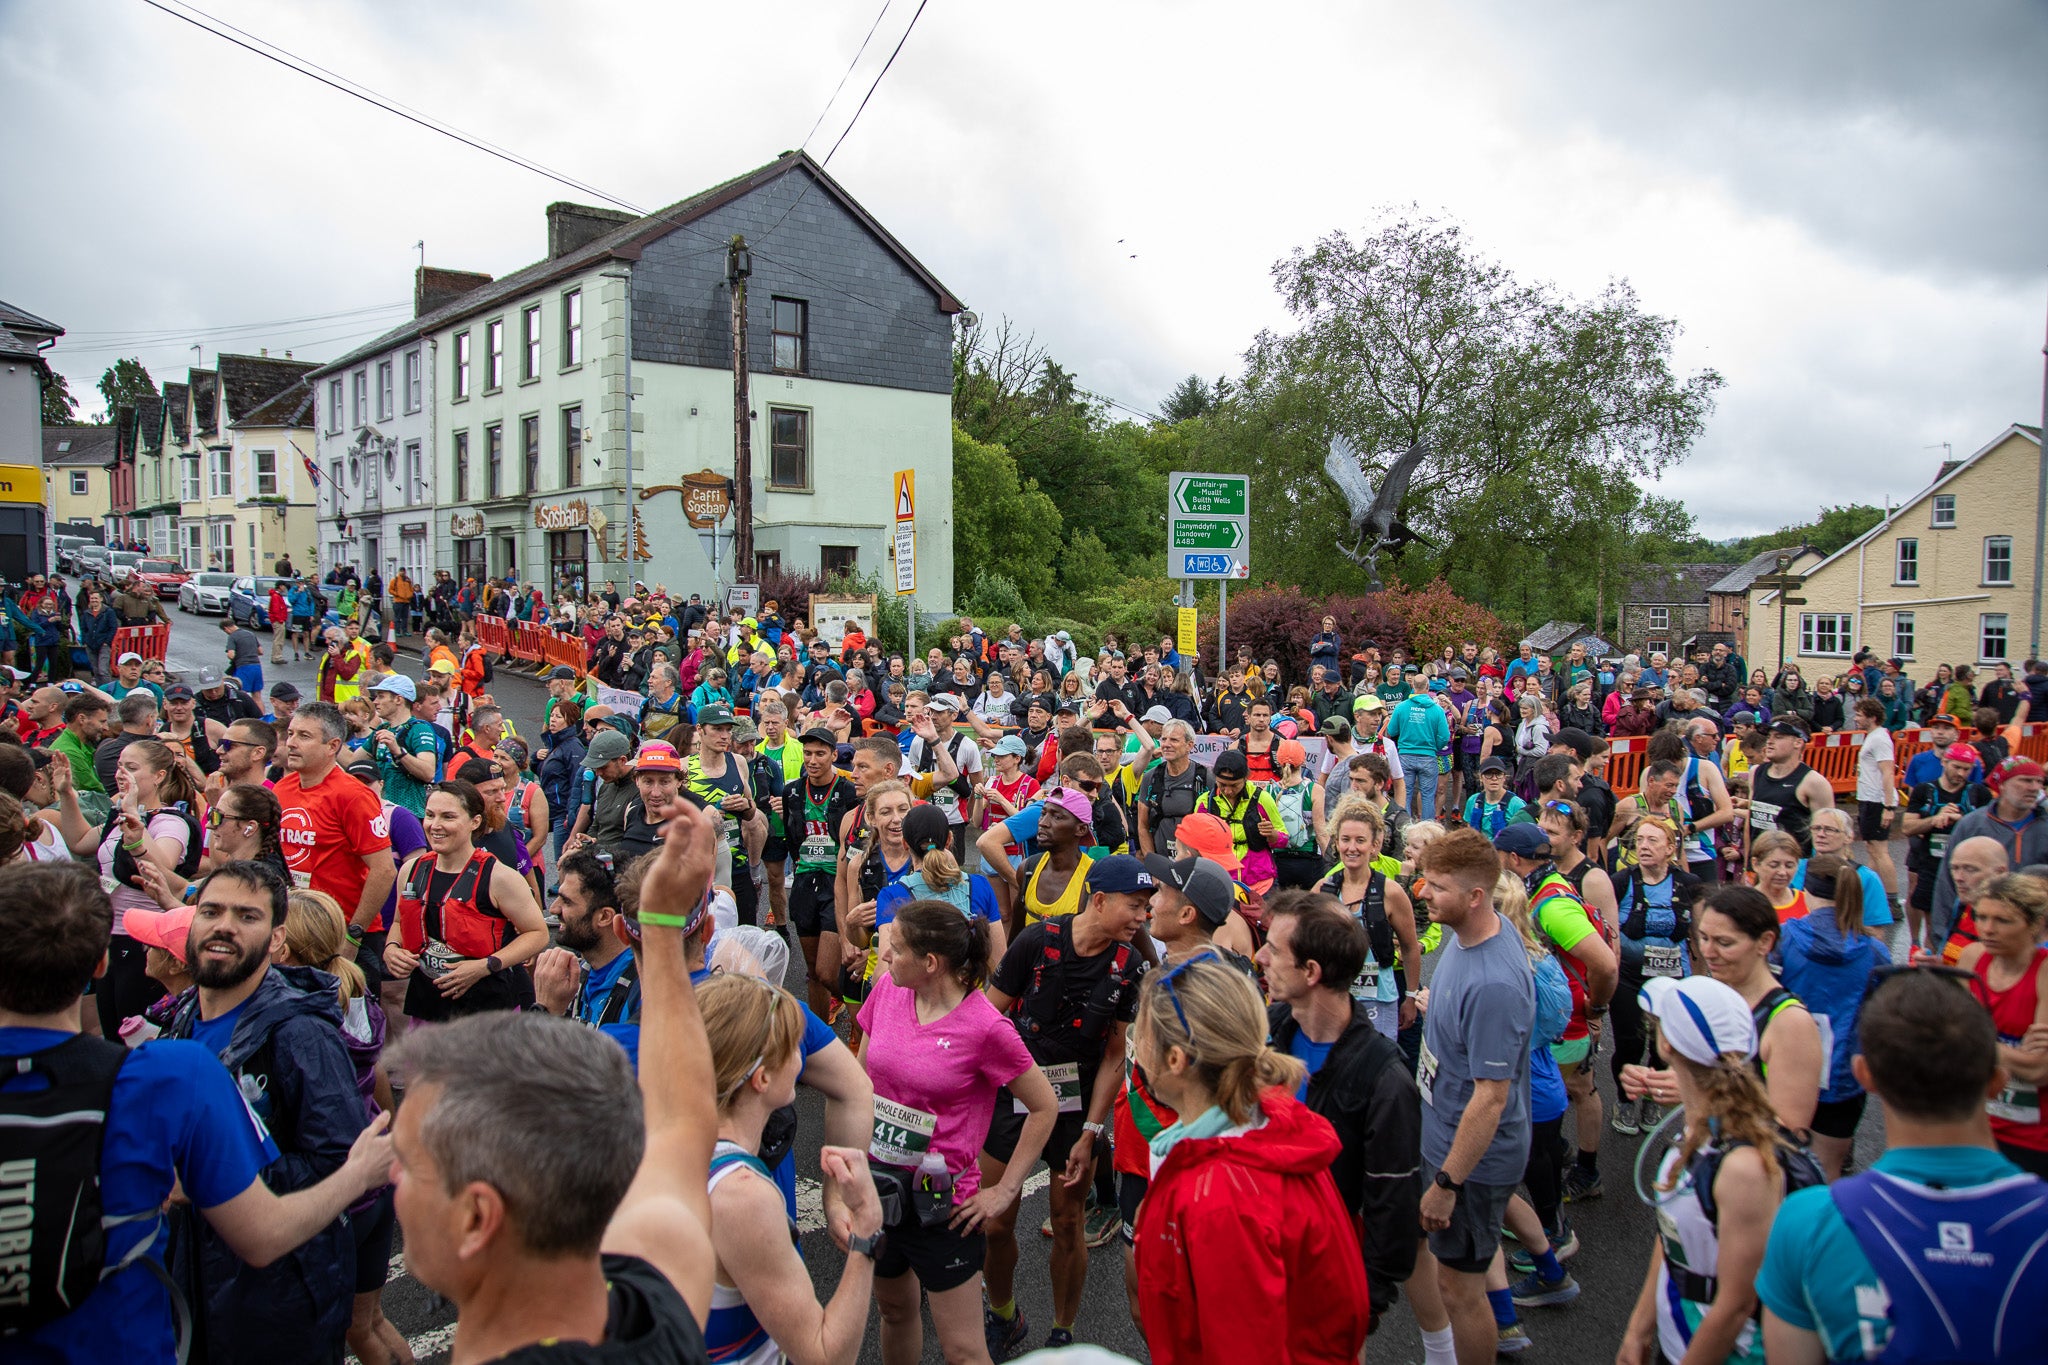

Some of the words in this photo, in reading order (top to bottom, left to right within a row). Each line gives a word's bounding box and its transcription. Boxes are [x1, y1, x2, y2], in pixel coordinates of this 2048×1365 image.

[692, 488, 720, 502] Caffi
[687, 500, 726, 514] Sosban
[540, 502, 579, 529] Sosban
[456, 515, 477, 537] Caffi
[1176, 522, 1217, 531] Llanymddyfri
[1176, 530, 1211, 538] Llandovery
[1198, 560, 1209, 568] WC
[286, 828, 317, 846] RACE
[807, 846, 825, 855] 756
[1648, 957, 1674, 968] 1045
[1364, 975, 1375, 986] A
[875, 1100, 899, 1118] WHOLE
[874, 1121, 908, 1148] 414
